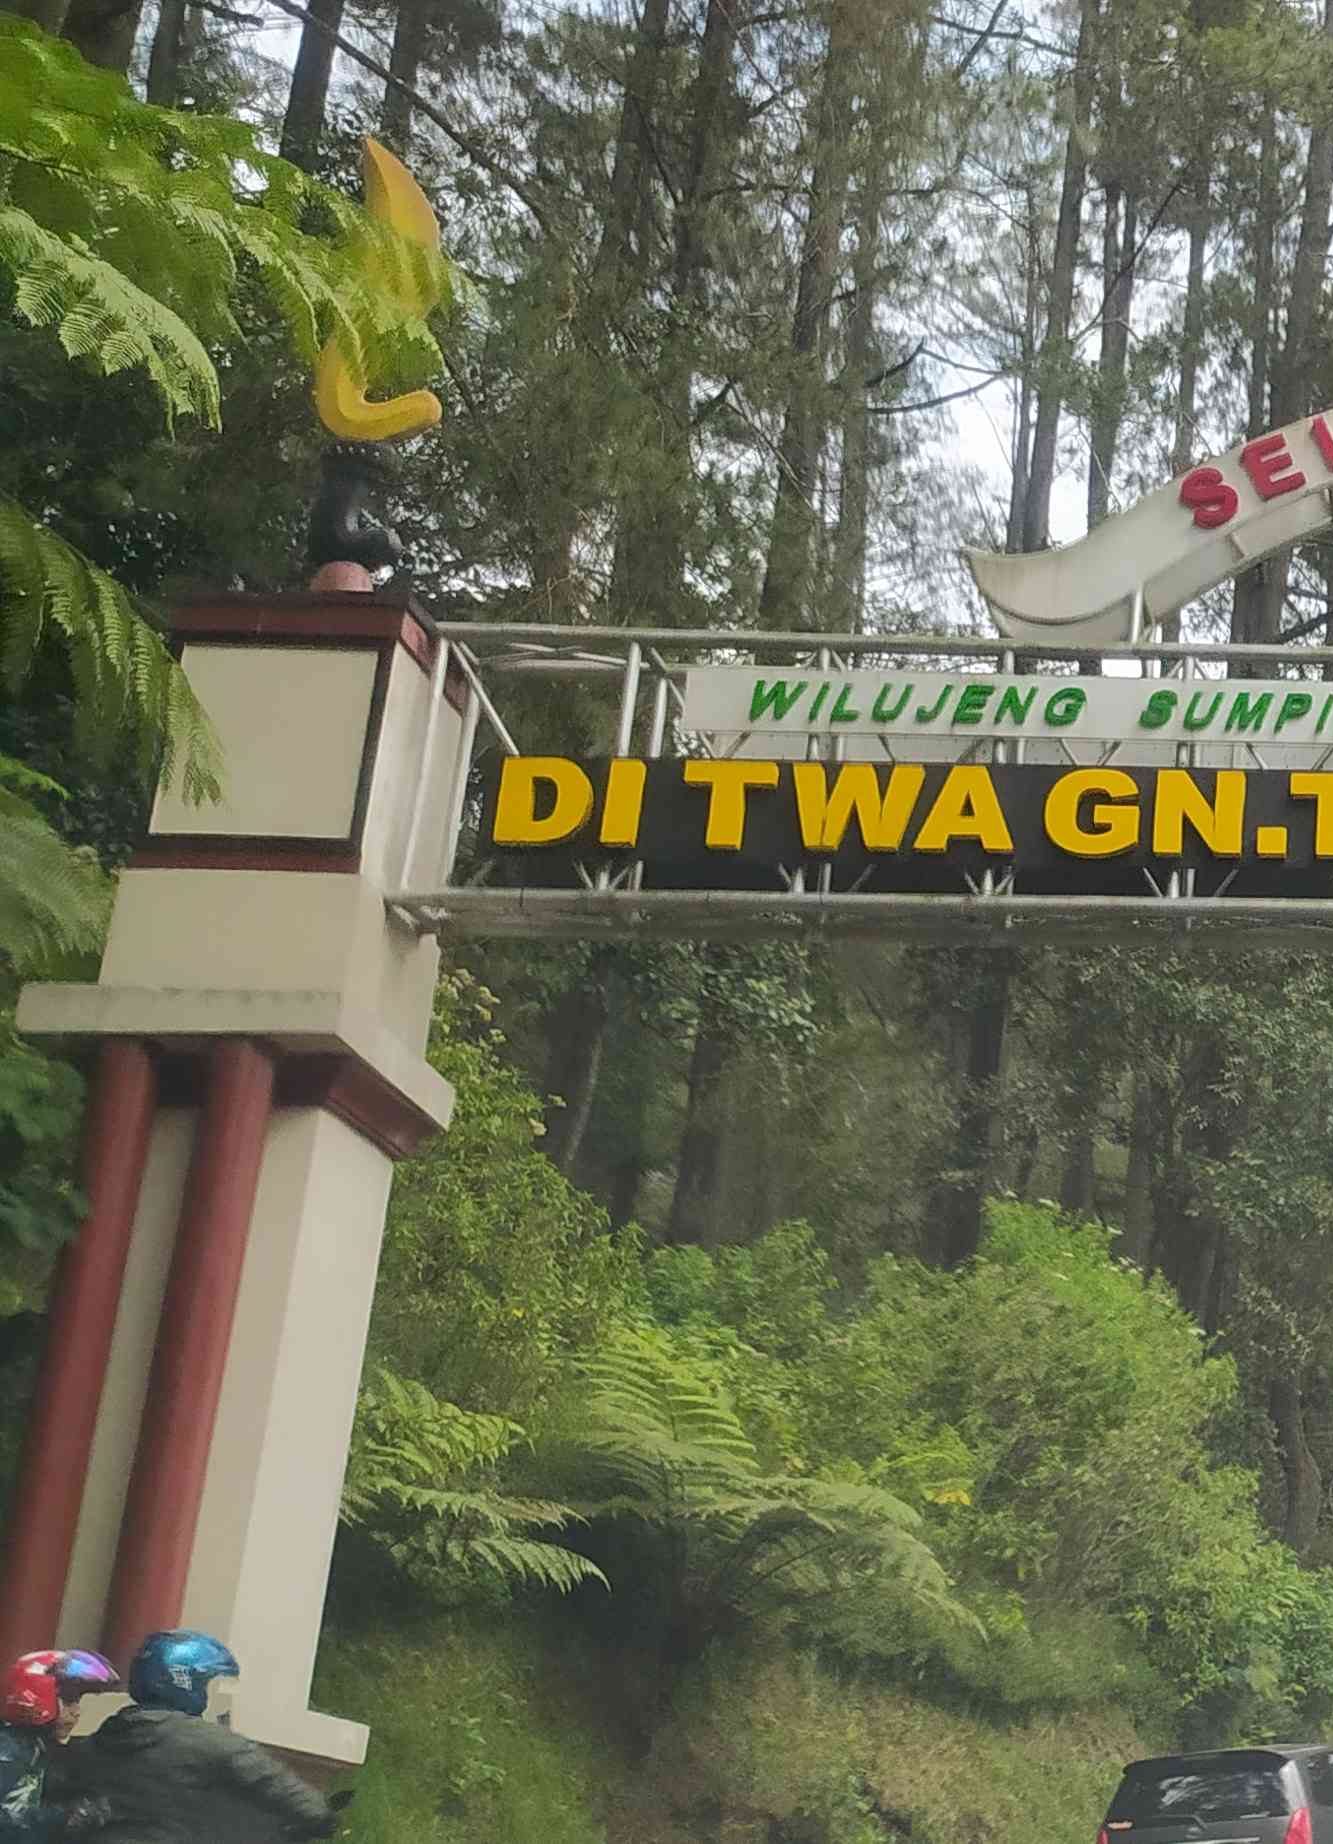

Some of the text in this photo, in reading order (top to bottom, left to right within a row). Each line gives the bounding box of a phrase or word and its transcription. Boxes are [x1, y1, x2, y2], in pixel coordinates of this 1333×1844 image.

[747, 678, 1088, 727] WILUJENG
[491, 755, 648, 849] DI
[682, 758, 1014, 853] TWA
